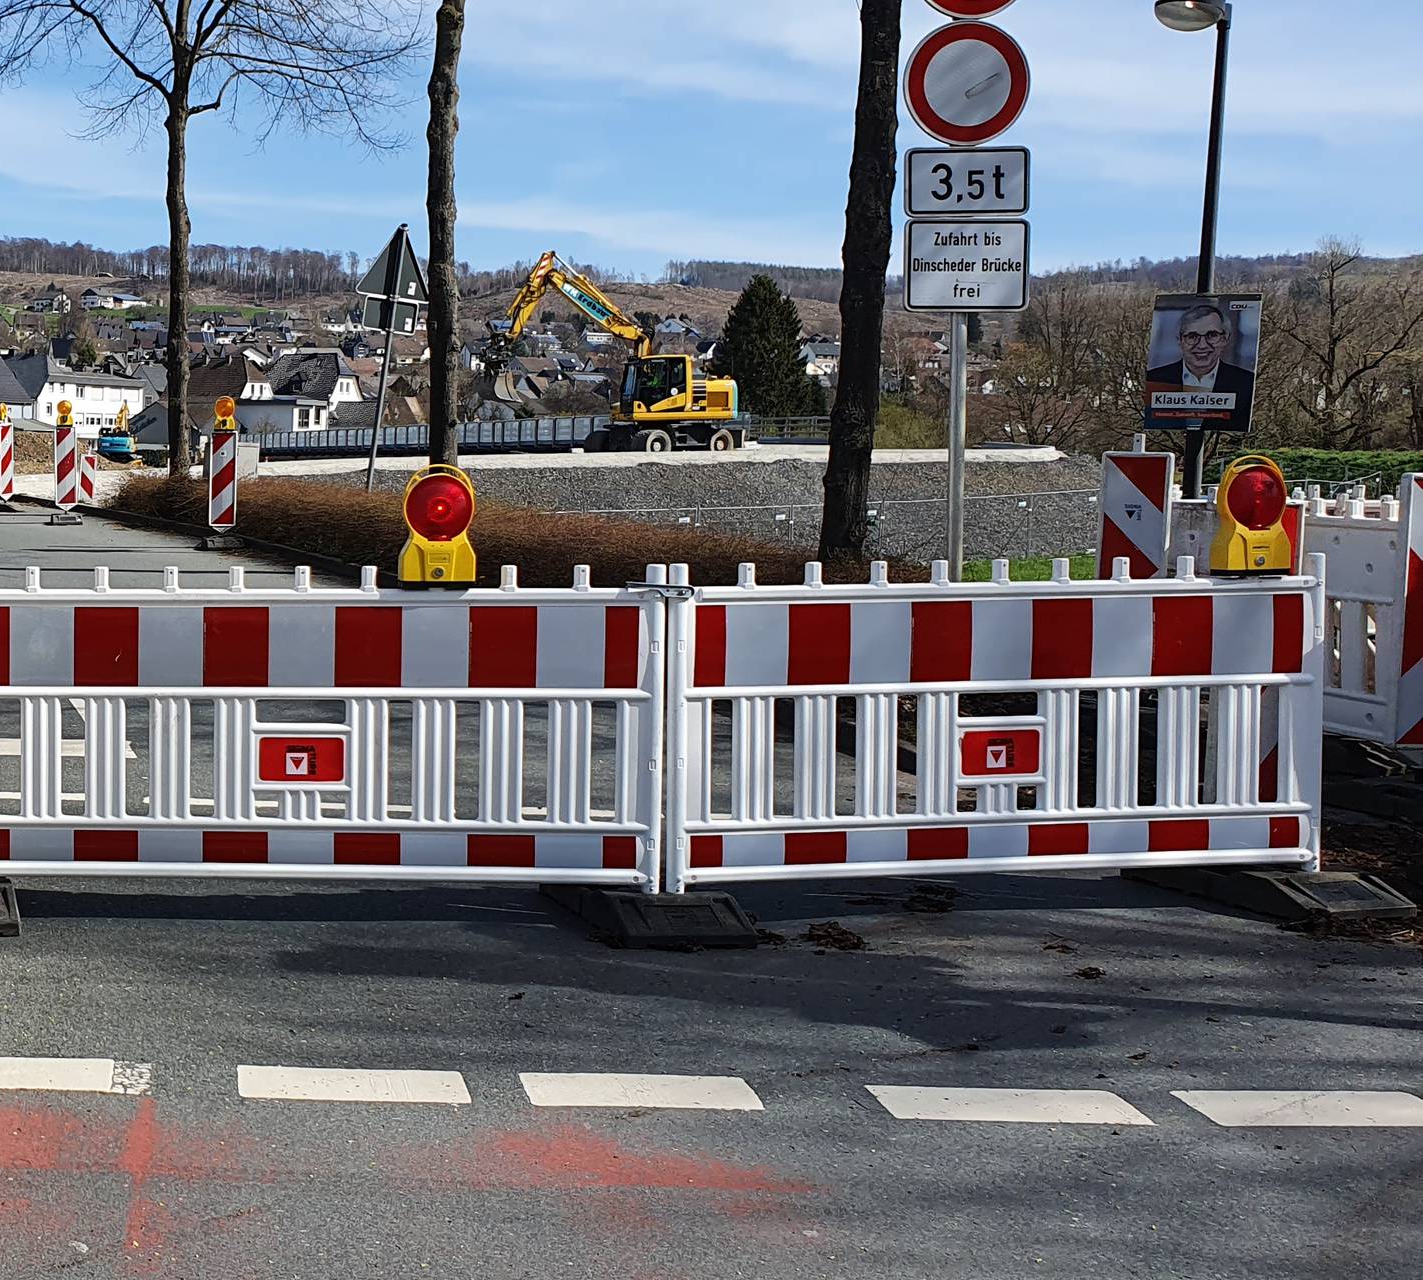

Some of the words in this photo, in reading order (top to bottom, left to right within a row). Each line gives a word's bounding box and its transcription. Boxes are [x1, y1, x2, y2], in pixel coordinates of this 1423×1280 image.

[933, 231, 978, 246] Zufahrt
[984, 231, 1002, 246] bis
[912, 257, 977, 273] Dinscheder
[981, 257, 1022, 273] Brücke
[953, 284, 981, 298] frei
[1154, 394, 1187, 405] Klaus
[1190, 395, 1229, 406] Kaiser
